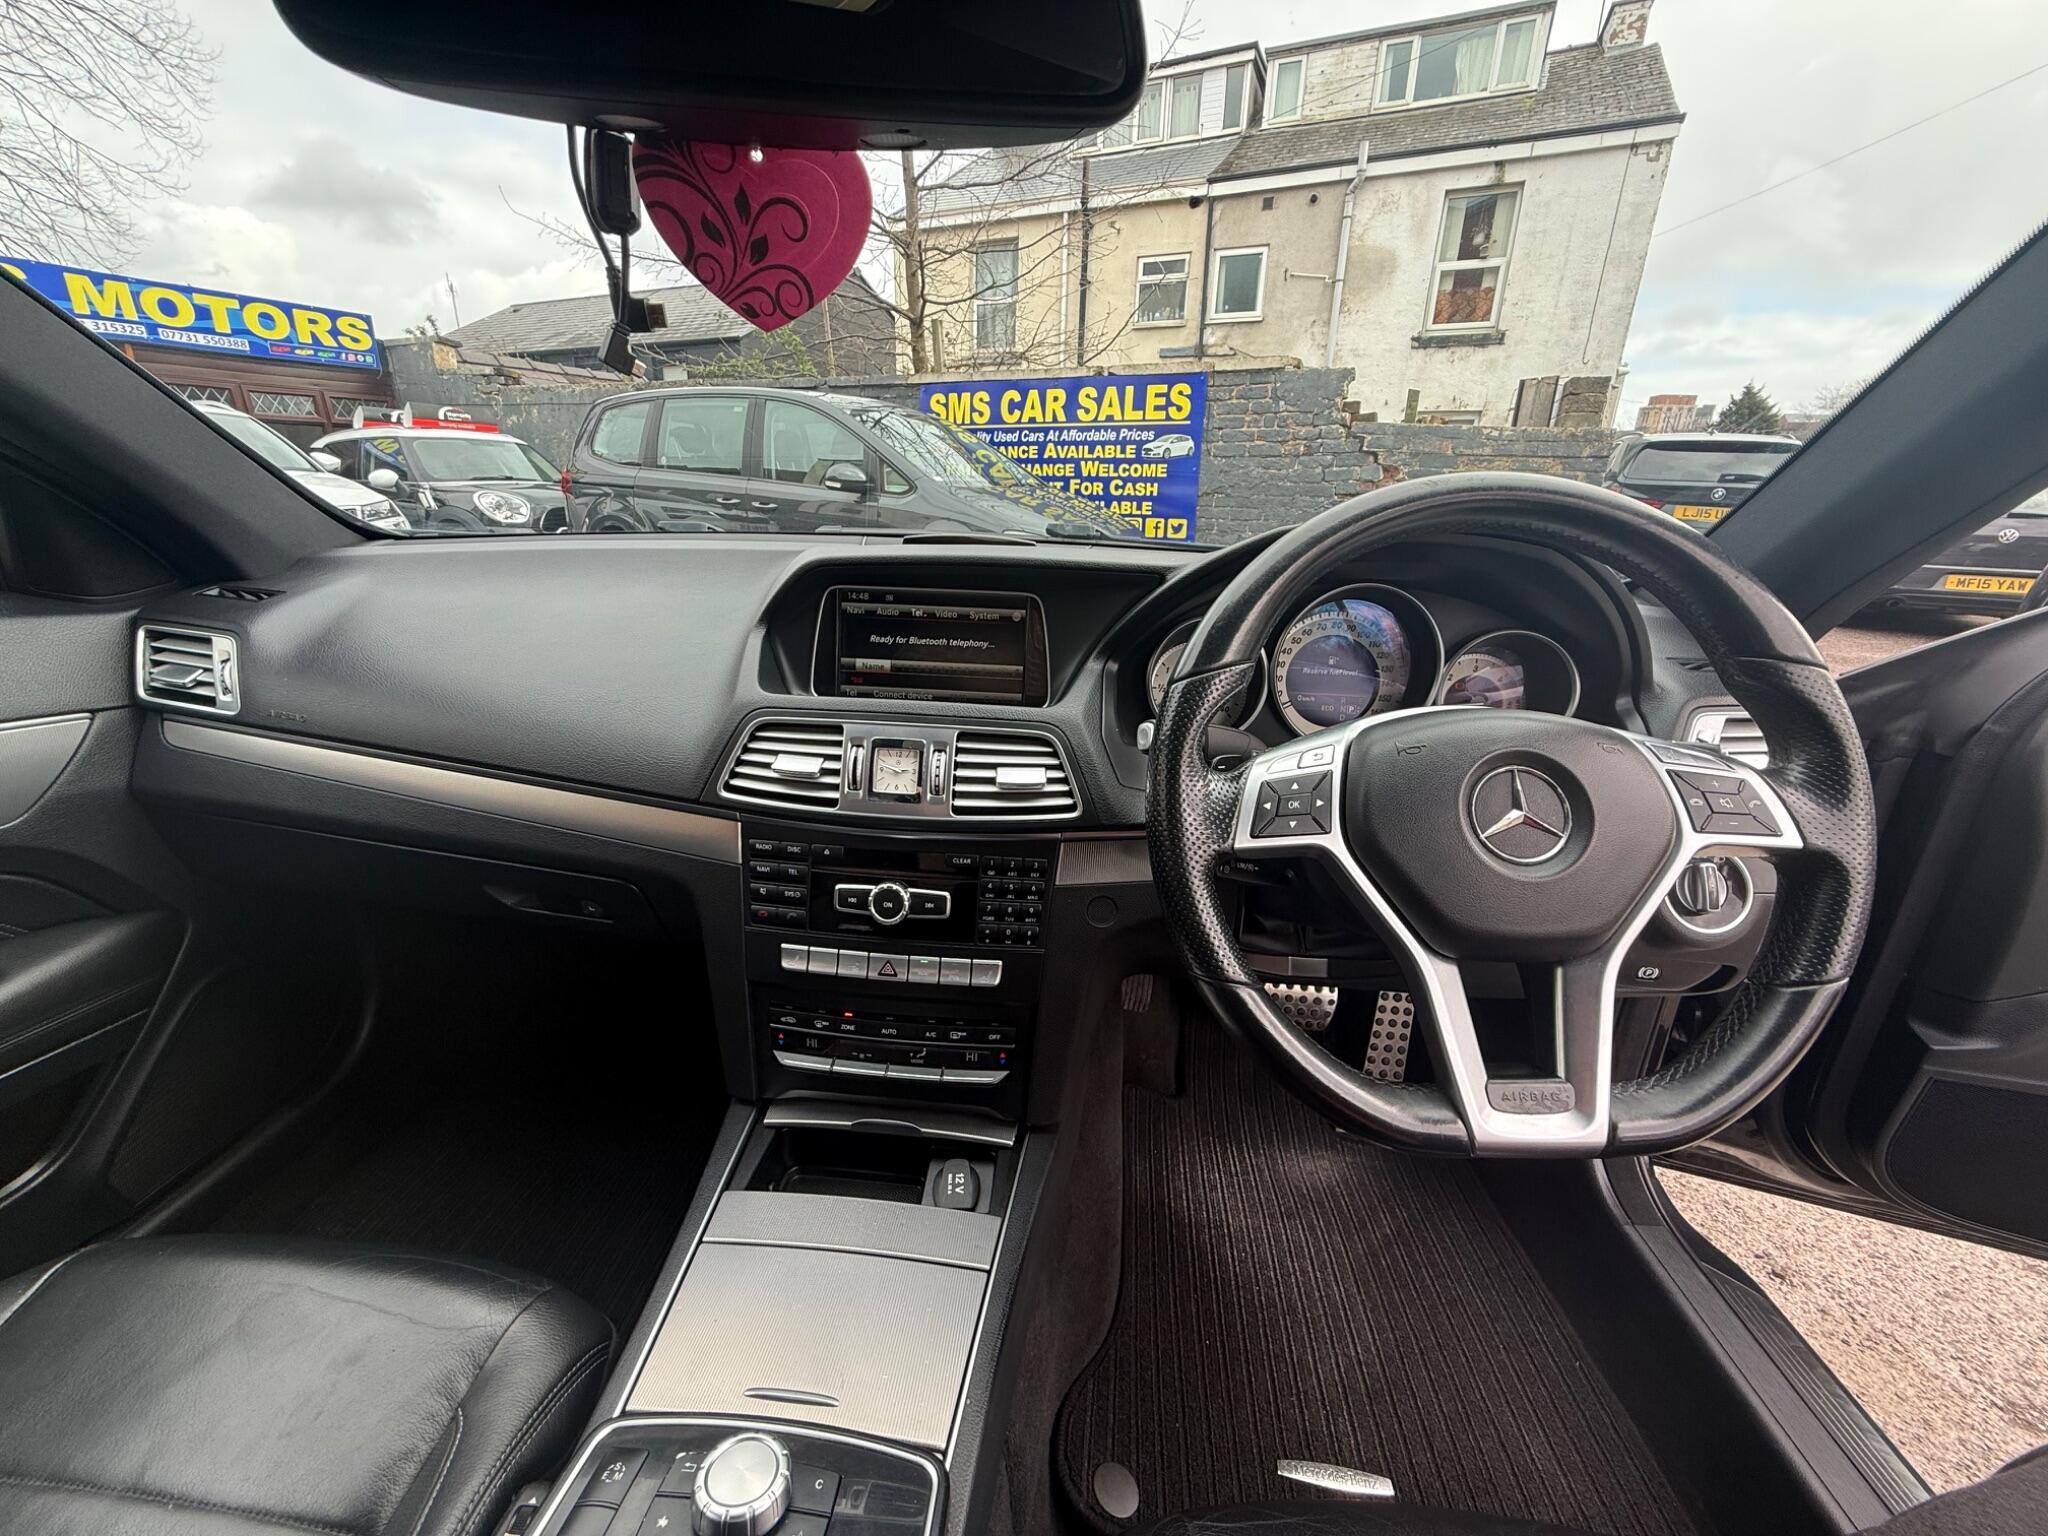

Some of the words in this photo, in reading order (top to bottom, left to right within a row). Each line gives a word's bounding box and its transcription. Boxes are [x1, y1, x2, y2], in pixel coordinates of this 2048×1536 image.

[63, 272, 373, 351] MOTORS
[92, 321, 145, 336] 315325
[160, 329, 199, 343] 07731
[203, 335, 248, 349] 550388
[930, 390, 991, 425] SMS
[1000, 388, 1067, 424] CAR
[1076, 382, 1192, 422] SALES
[993, 430, 1019, 443] Used
[1021, 429, 1045, 442] Cars
[1046, 429, 1060, 441] At
[1060, 428, 1117, 441] Affordable
[1119, 428, 1155, 441] Prices
[1109, 479, 1159, 496] CASH
[1682, 507, 1713, 519] LJ15
[1955, 577, 1993, 589] MF15
[1997, 579, 2028, 591] YAW
[848, 592, 869, 600] 14:48
[846, 606, 865, 615] Navi
[877, 607, 900, 616] Audio
[911, 608, 928, 617] Tel.
[935, 609, 958, 619] Video
[969, 610, 1000, 621] System
[1316, 623, 1327, 631] 70
[1346, 624, 1356, 632] 90
[869, 634, 895, 645] Ready
[896, 636, 908, 644] for
[908, 636, 948, 646] Bluetooth
[862, 662, 885, 671] Name
[873, 689, 906, 699] Connect
[907, 691, 934, 700] device
[1288, 800, 1300, 809] OK
[952, 857, 972, 865] CLEAR
[788, 868, 799, 876] TEL
[806, 1038, 818, 1048] HI
[966, 1051, 978, 1062] HI
[1501, 1091, 1562, 1102] AIRBAG
[1292, 1463, 1378, 1490] Mercedes-Benz
[815, 1479, 824, 1489] C
